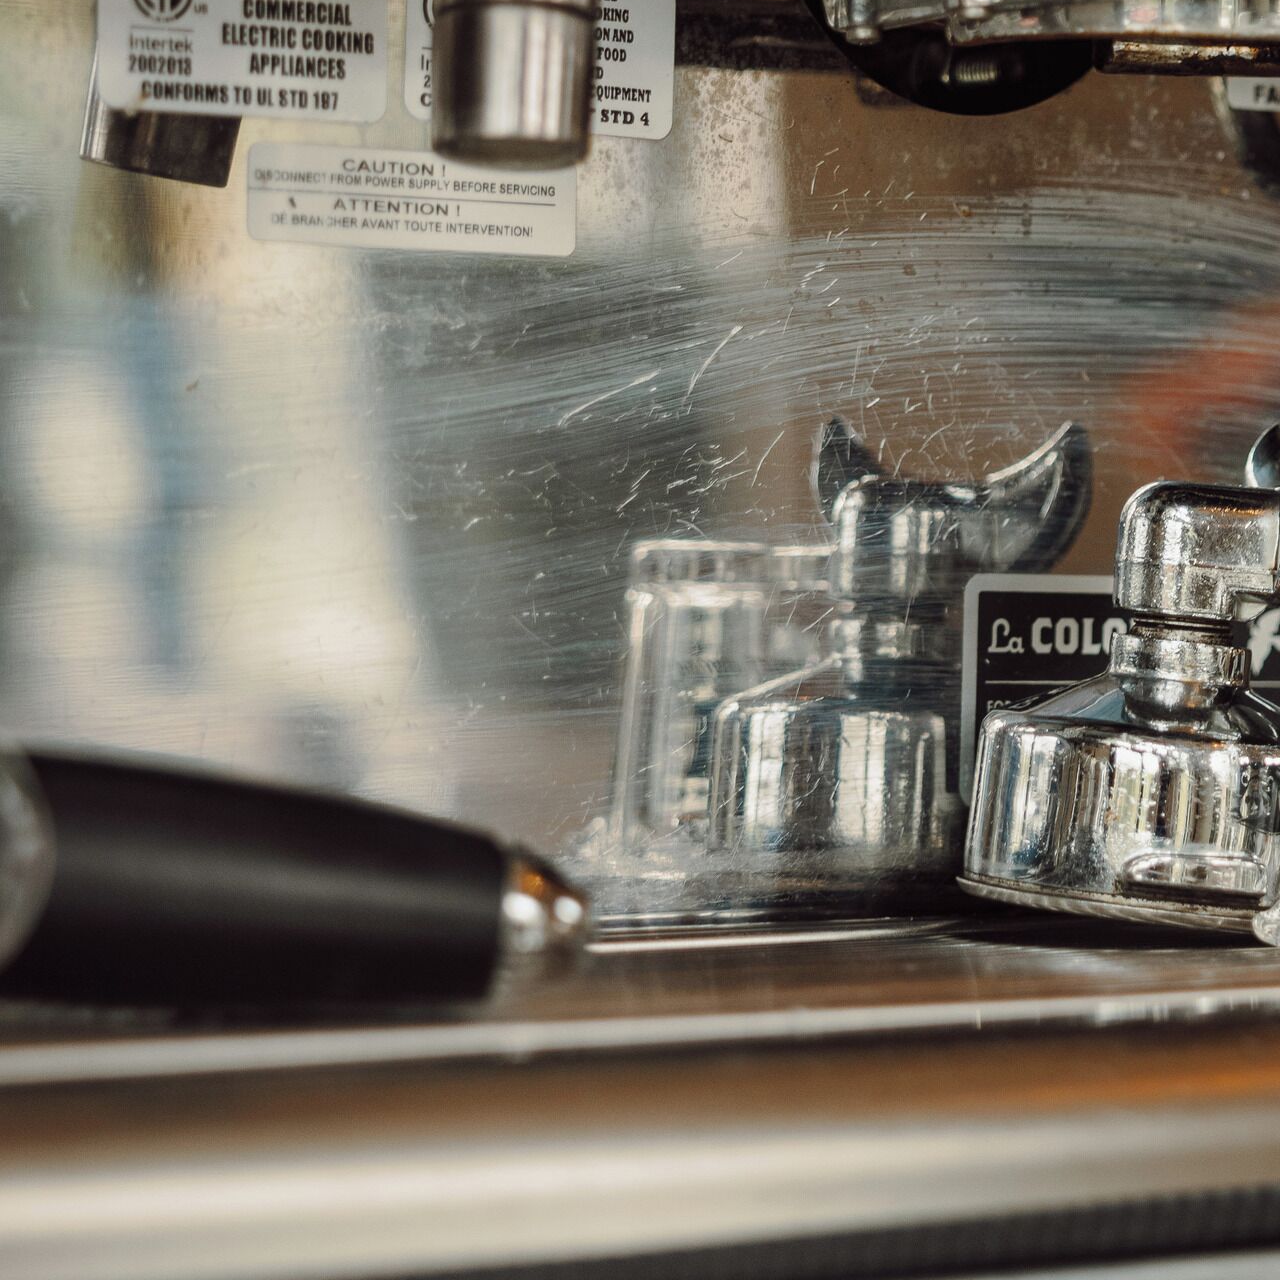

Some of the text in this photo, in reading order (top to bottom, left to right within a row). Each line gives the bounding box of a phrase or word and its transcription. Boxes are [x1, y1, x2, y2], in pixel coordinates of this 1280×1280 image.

[129, 33, 193, 53] Intertek
[222, 22, 374, 55] ELECTRIC COOKING
[612, 28, 634, 43] AND
[597, 47, 627, 62] FOOD
[249, 52, 346, 80] APPLIANCES
[141, 80, 228, 104] CONFORMS
[234, 86, 251, 105] TO
[257, 88, 274, 107] UL
[279, 89, 308, 109] STD
[596, 85, 651, 102] QUIPMENT
[600, 109, 650, 127] STD 4
[342, 159, 434, 177] CAUTION
[331, 173, 362, 187] FROM
[365, 175, 405, 189] POWER
[408, 178, 450, 192] SUPPLY
[453, 180, 497, 195] BEFORE
[500, 184, 556, 198] SERVICING
[333, 197, 449, 216] ATTENTION
[361, 217, 401, 231] AVANT
[405, 221, 442, 233] TOUTE
[446, 223, 533, 238] INTERVENTION!
[987, 616, 1134, 656] La COLO
